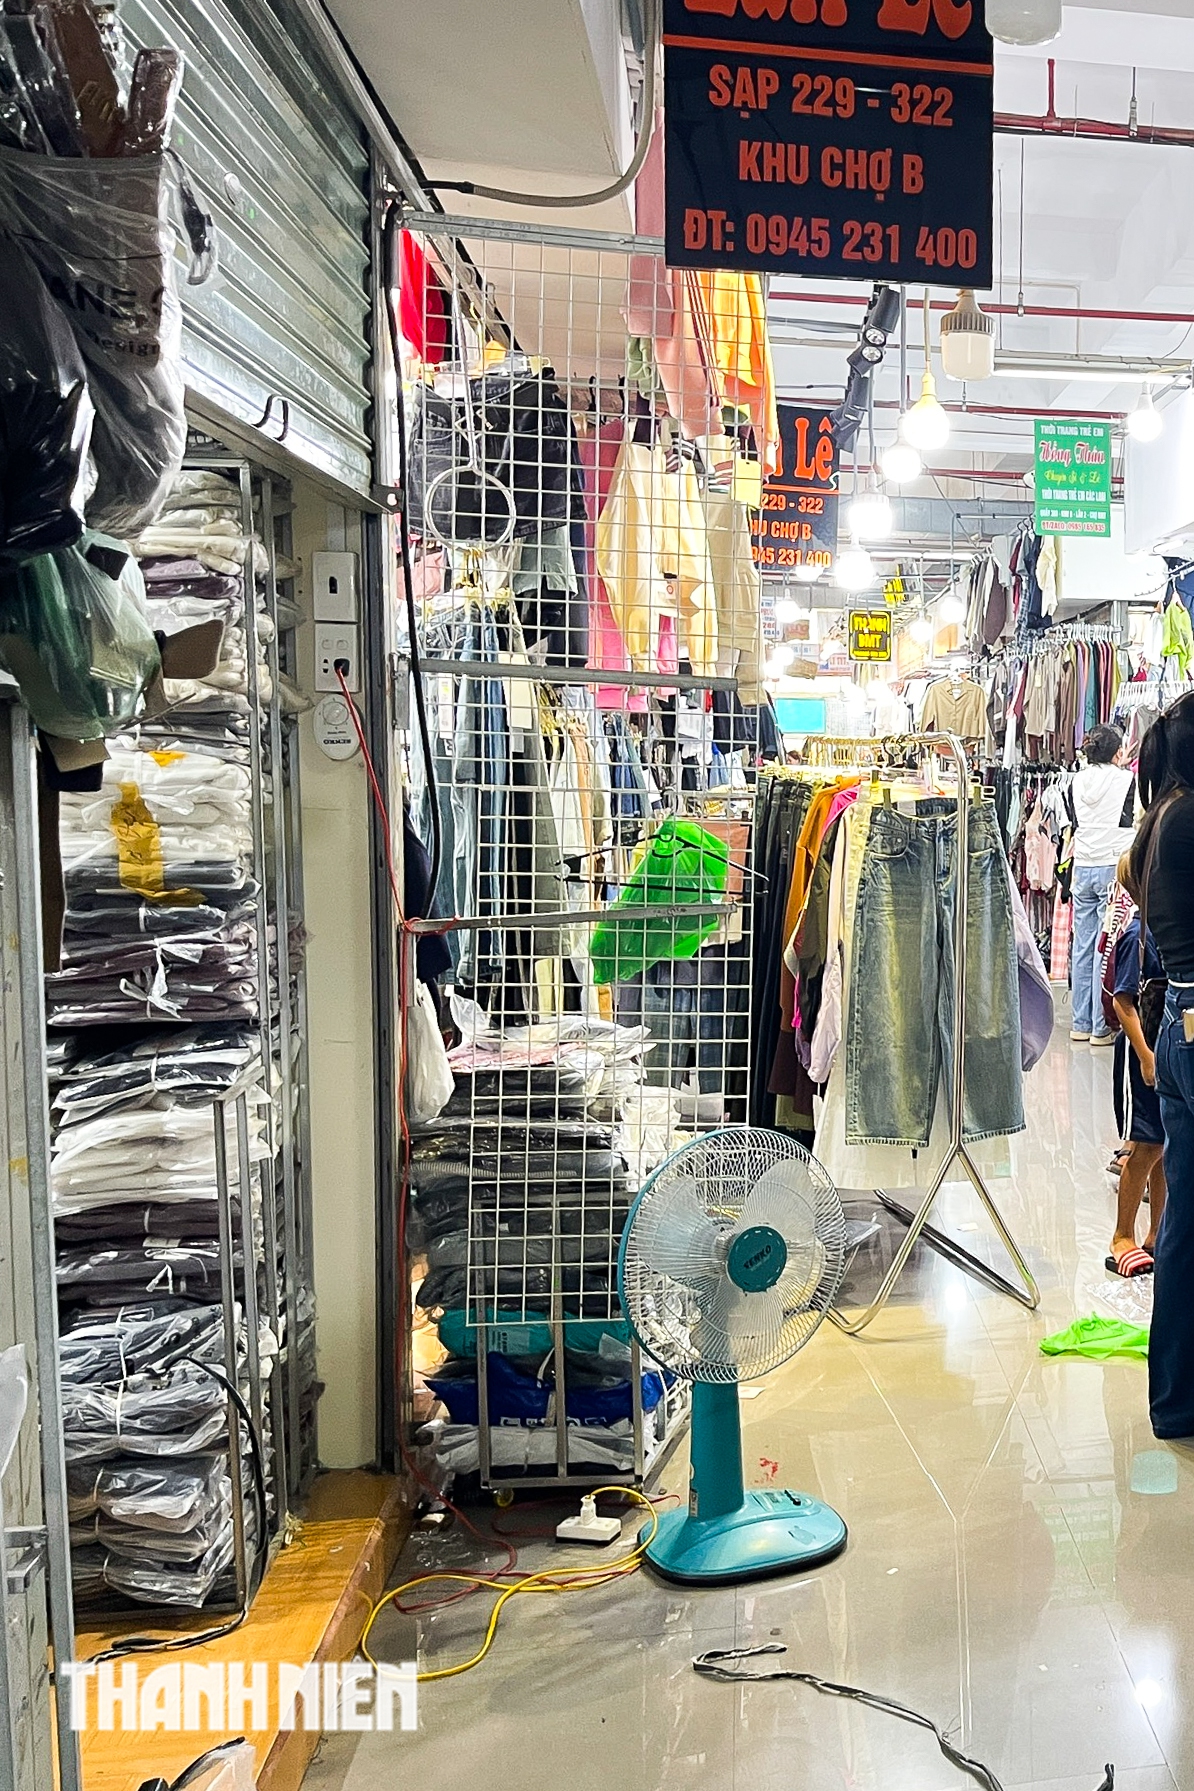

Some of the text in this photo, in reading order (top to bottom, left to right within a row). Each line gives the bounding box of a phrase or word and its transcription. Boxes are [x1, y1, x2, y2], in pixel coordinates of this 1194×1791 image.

[708, 64, 953, 127] SẠP 229 - 322
[738, 140, 924, 201] KHU CHỢ B
[683, 208, 978, 270] ĐT: 0945 231 400
[794, 416, 834, 481] Lê
[761, 493, 787, 511] 229
[798, 496, 824, 514] 322
[751, 519, 812, 543] HU CHỢ B
[751, 546, 832, 568] 945 231 400
[744, 1244, 772, 1269] SENKO
